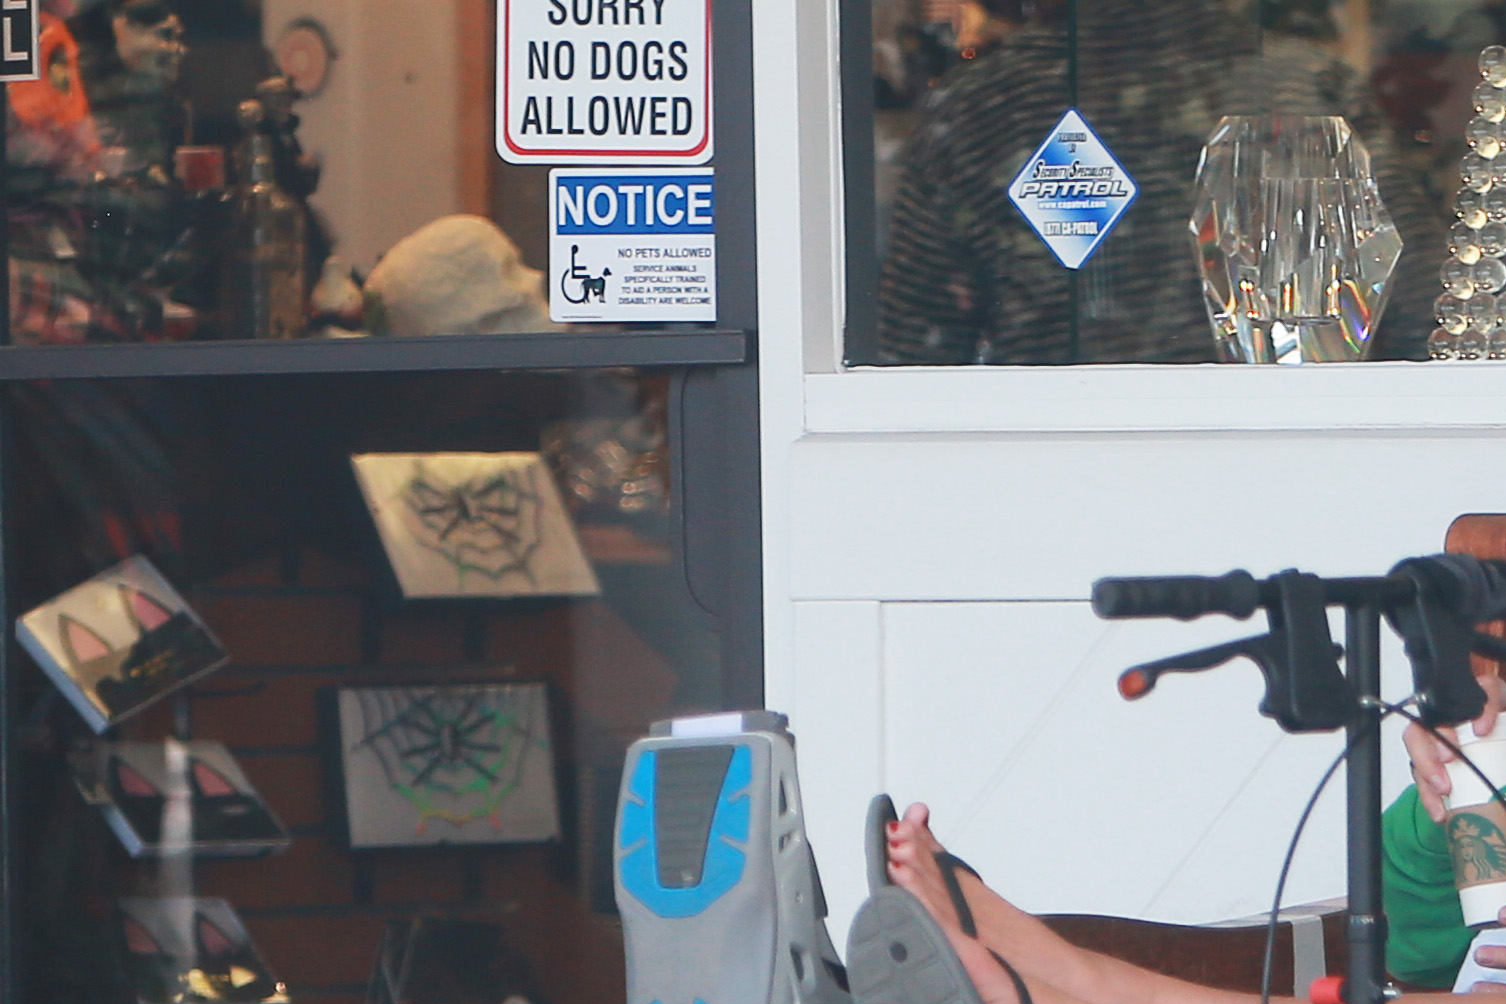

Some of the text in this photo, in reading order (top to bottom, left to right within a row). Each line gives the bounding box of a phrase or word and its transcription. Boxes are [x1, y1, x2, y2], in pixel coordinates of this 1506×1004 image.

[528, 40, 688, 81] NO DOGS
[520, 96, 693, 135] ALLOWED
[558, 184, 713, 226] NOTICE
[1019, 181, 1128, 198] PATROL
[618, 248, 712, 258] NO PETS ALLOWED
